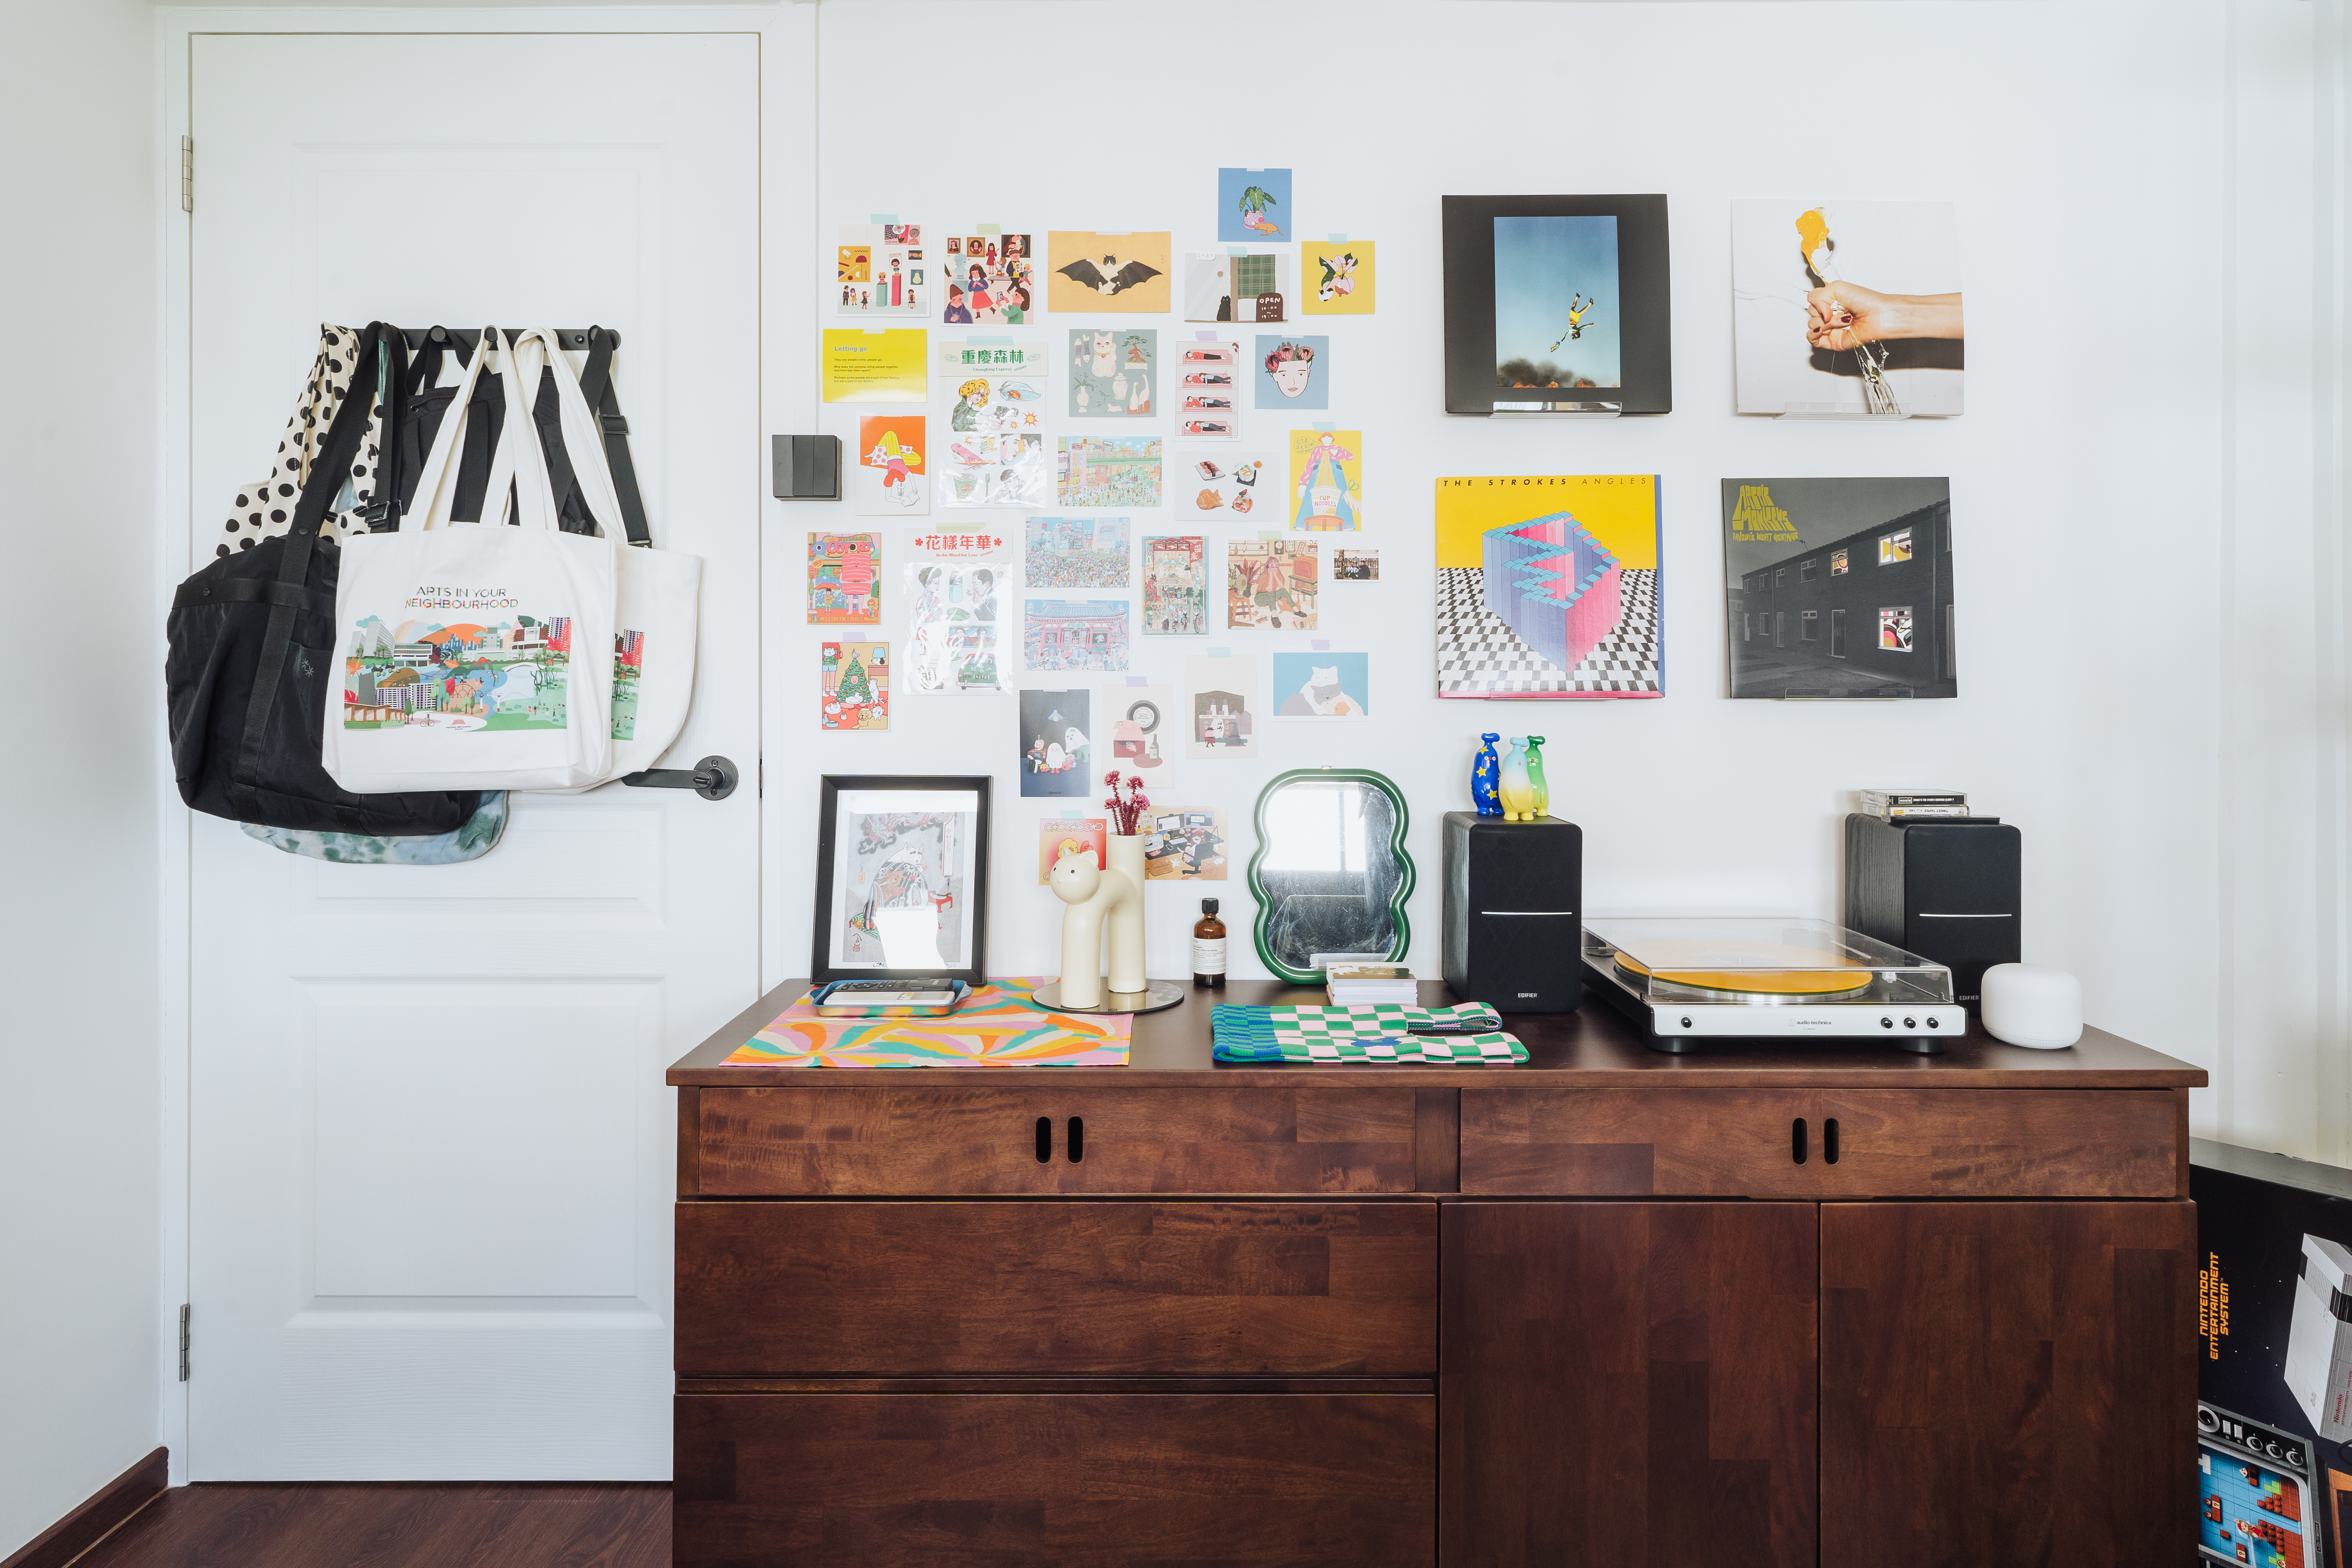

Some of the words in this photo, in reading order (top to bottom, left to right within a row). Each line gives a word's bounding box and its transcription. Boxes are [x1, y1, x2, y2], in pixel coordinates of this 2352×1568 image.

[961, 350, 1024, 364] 重慶森林
[1732, 484, 1774, 520] ARCTIC
[1732, 507, 1797, 531] MONKEYS
[826, 541, 871, 554] OOTORO
[926, 535, 991, 550] 花樣年華
[405, 598, 518, 610] NEIGHBOURHOOD
[416, 586, 452, 597] ARTS
[456, 588, 468, 598] IN
[472, 588, 507, 598] YOUR
[2199, 1270, 2208, 1336] NINTENDO
[2210, 1252, 2219, 1360] ENTERTAINMENT
[2333, 1394, 2343, 1423] Nintendo
[2341, 1390, 2350, 1425] ENTERTAINMENT
